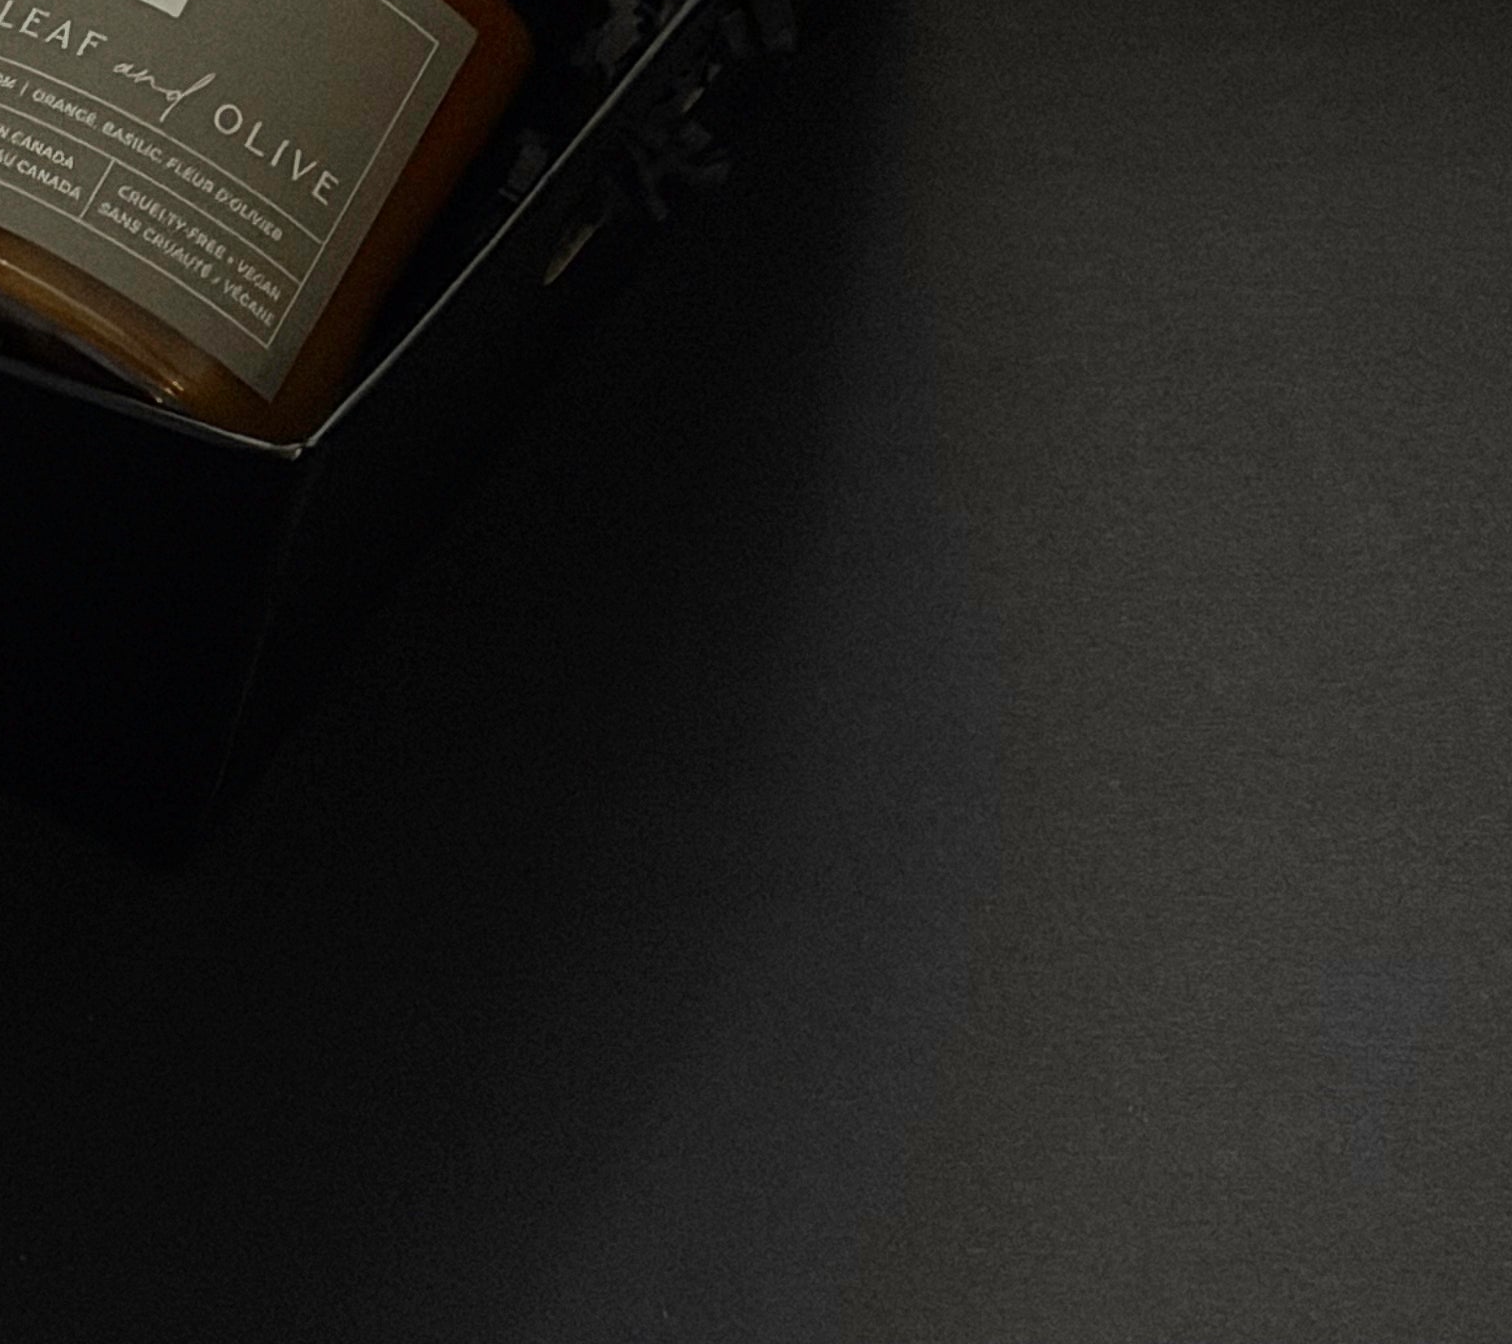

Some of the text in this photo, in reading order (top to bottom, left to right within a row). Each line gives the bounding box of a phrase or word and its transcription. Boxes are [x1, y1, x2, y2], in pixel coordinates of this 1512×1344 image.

[11, 129, 74, 170] CANADA
[112, 60, 216, 123] and
[213, 103, 340, 206] OLIVE
[16, 159, 83, 200] CANADA
[166, 157, 215, 193] FLEUR
[98, 202, 142, 234] SANS
[237, 259, 281, 302] VEGAN
